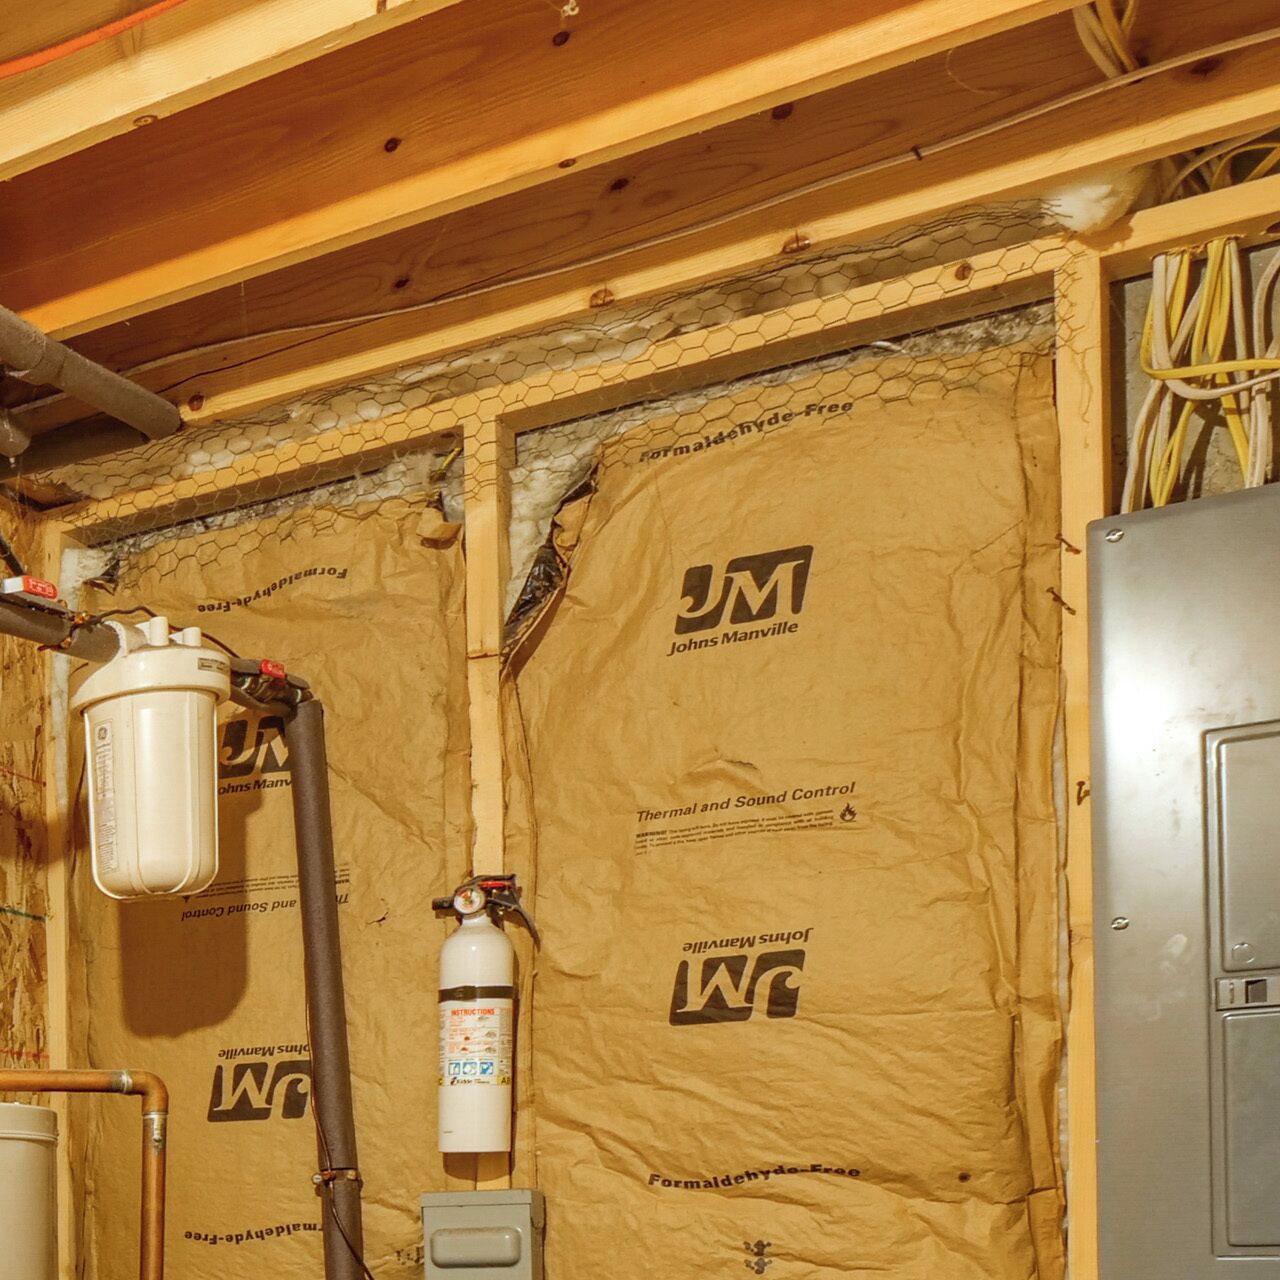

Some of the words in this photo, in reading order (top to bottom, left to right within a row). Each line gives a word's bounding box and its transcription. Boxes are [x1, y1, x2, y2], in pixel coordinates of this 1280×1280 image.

[667, 637, 719, 657] Johns
[721, 621, 799, 645] Manville
[218, 778, 252, 796] ohns
[636, 803, 697, 823] Thermal
[700, 797, 731, 814] and
[734, 790, 788, 809] Sound
[792, 781, 856, 801] Control
[181, 906, 225, 922] Control
[228, 902, 269, 914] Sound
[271, 898, 297, 912] and
[682, 935, 756, 954] Manville
[759, 928, 814, 945] Johns
[219, 1047, 276, 1060] Manville
[277, 1044, 310, 1056] ohns
[184, 1222, 323, 1245] maldehyde-Free
